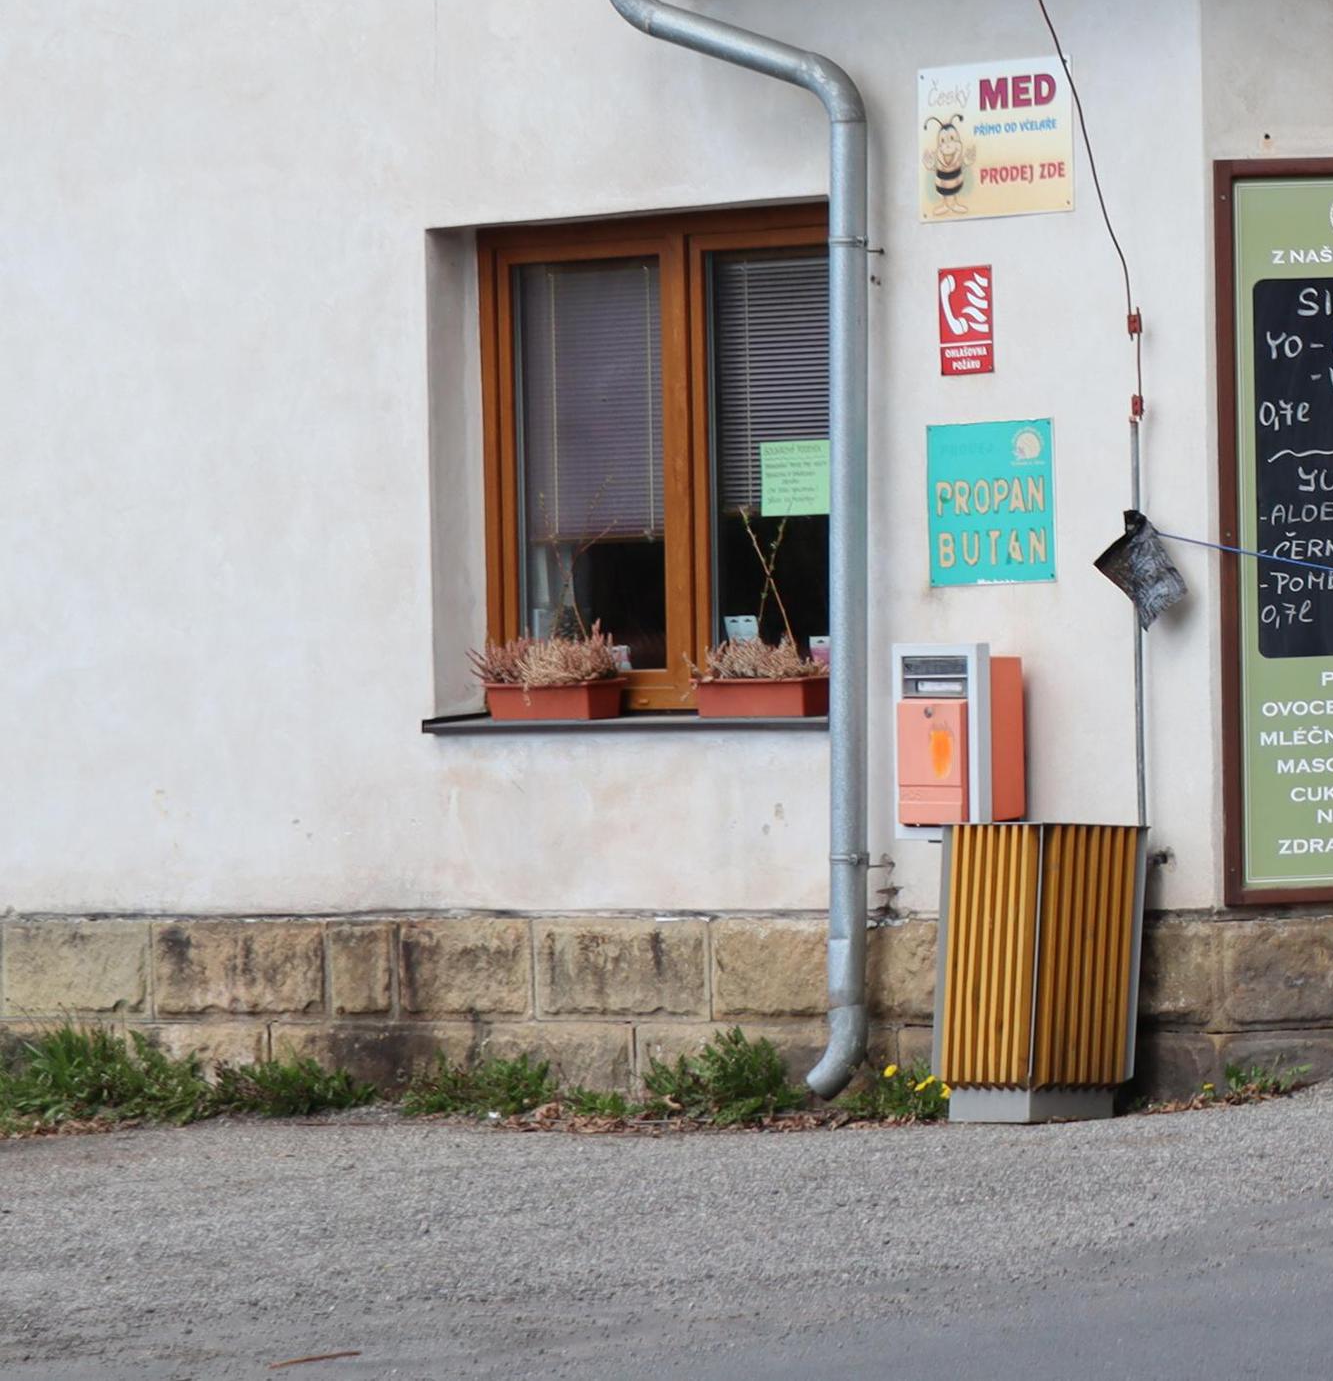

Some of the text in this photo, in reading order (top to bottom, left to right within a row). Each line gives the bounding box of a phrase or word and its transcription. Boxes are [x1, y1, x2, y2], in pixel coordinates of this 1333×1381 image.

[979, 73, 1057, 111] MED
[973, 117, 1057, 136] PŘÍMO OD VČELAŘE
[980, 161, 1066, 185] PRODEJ ZDE
[1271, 250, 1285, 265] Z
[944, 346, 988, 358] OHLAŠOVNA
[935, 475, 1045, 517] PROPAN
[937, 527, 1047, 569] BUTAN
